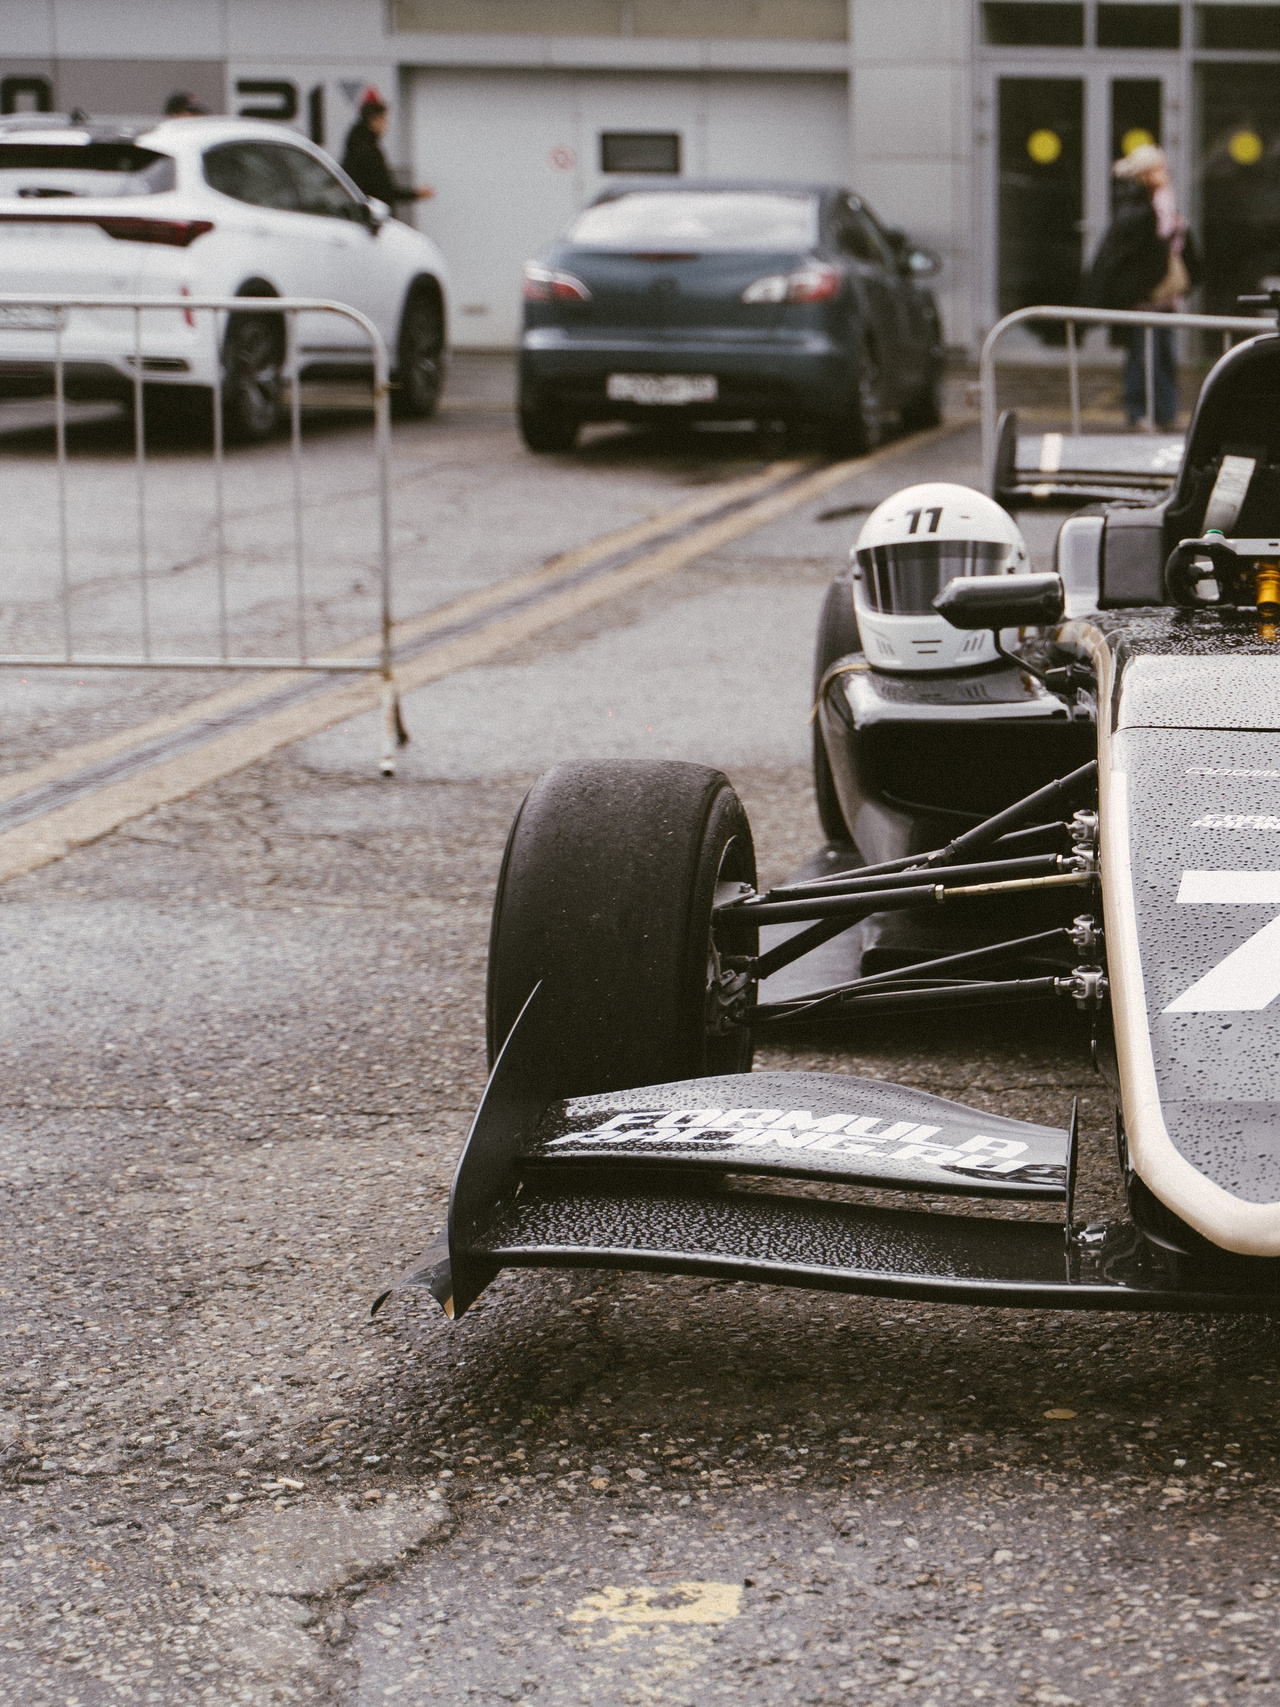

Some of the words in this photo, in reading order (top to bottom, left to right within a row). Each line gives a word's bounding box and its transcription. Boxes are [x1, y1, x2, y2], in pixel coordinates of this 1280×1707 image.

[906, 507, 943, 534] 11
[544, 1128, 1031, 1174] RACING.RU
[598, 1108, 1030, 1158] FORMULA
